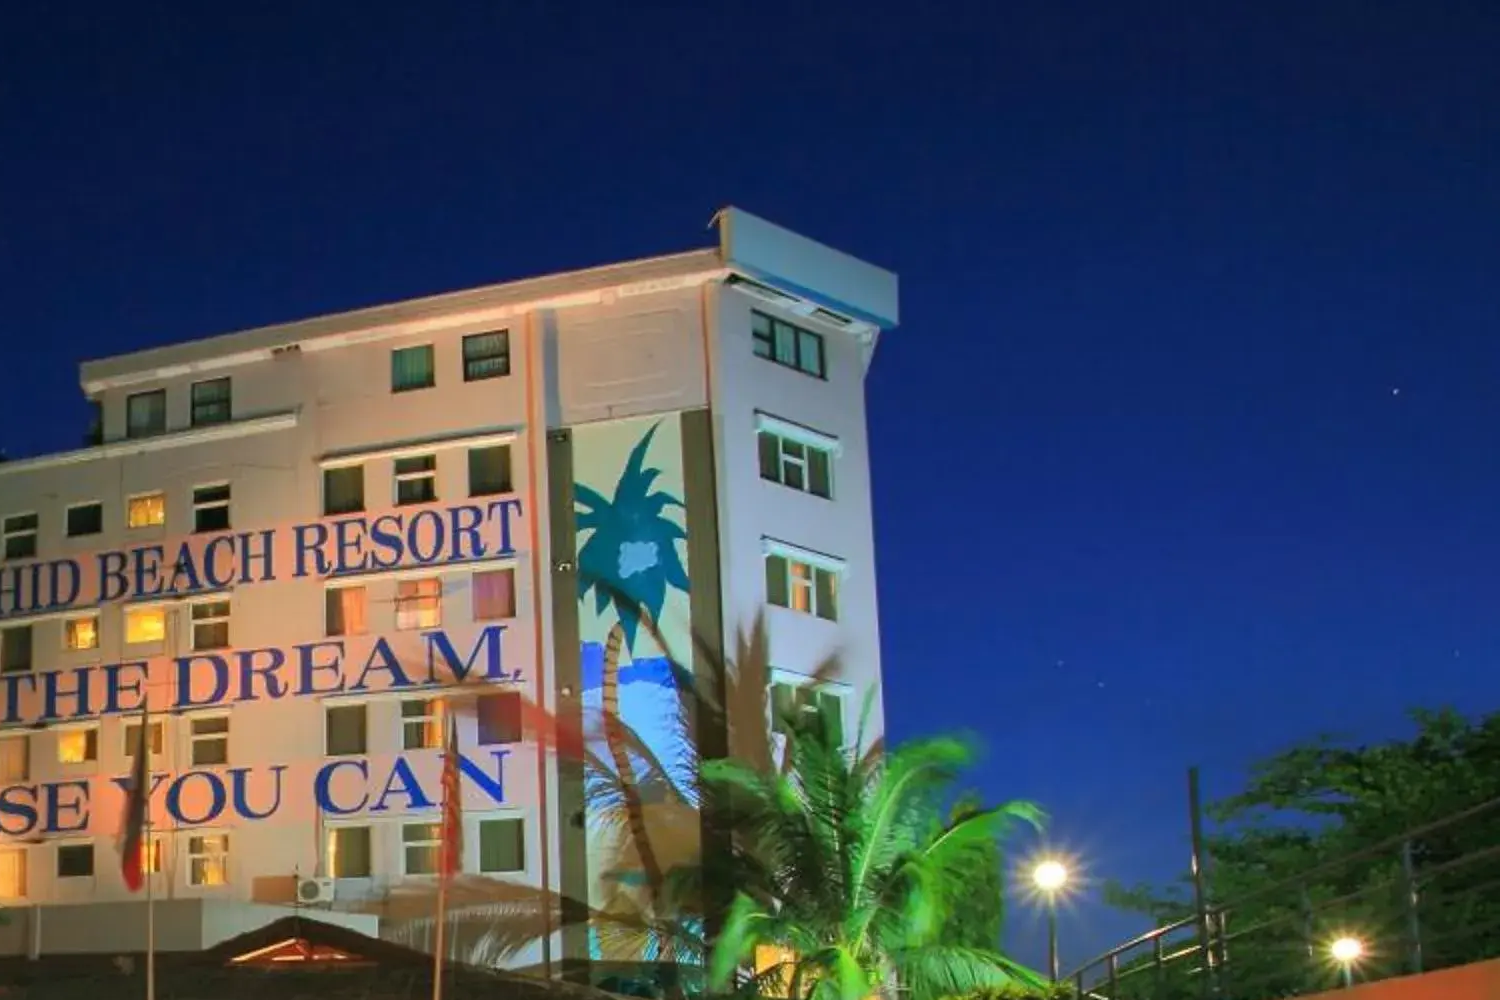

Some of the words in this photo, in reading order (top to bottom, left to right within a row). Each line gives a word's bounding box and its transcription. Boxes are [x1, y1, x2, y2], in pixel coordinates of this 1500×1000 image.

[96, 529, 276, 602] BEACH
[292, 499, 523, 578] RESORT
[171, 625, 524, 708] DREAM,
[314, 749, 511, 815] CAN
